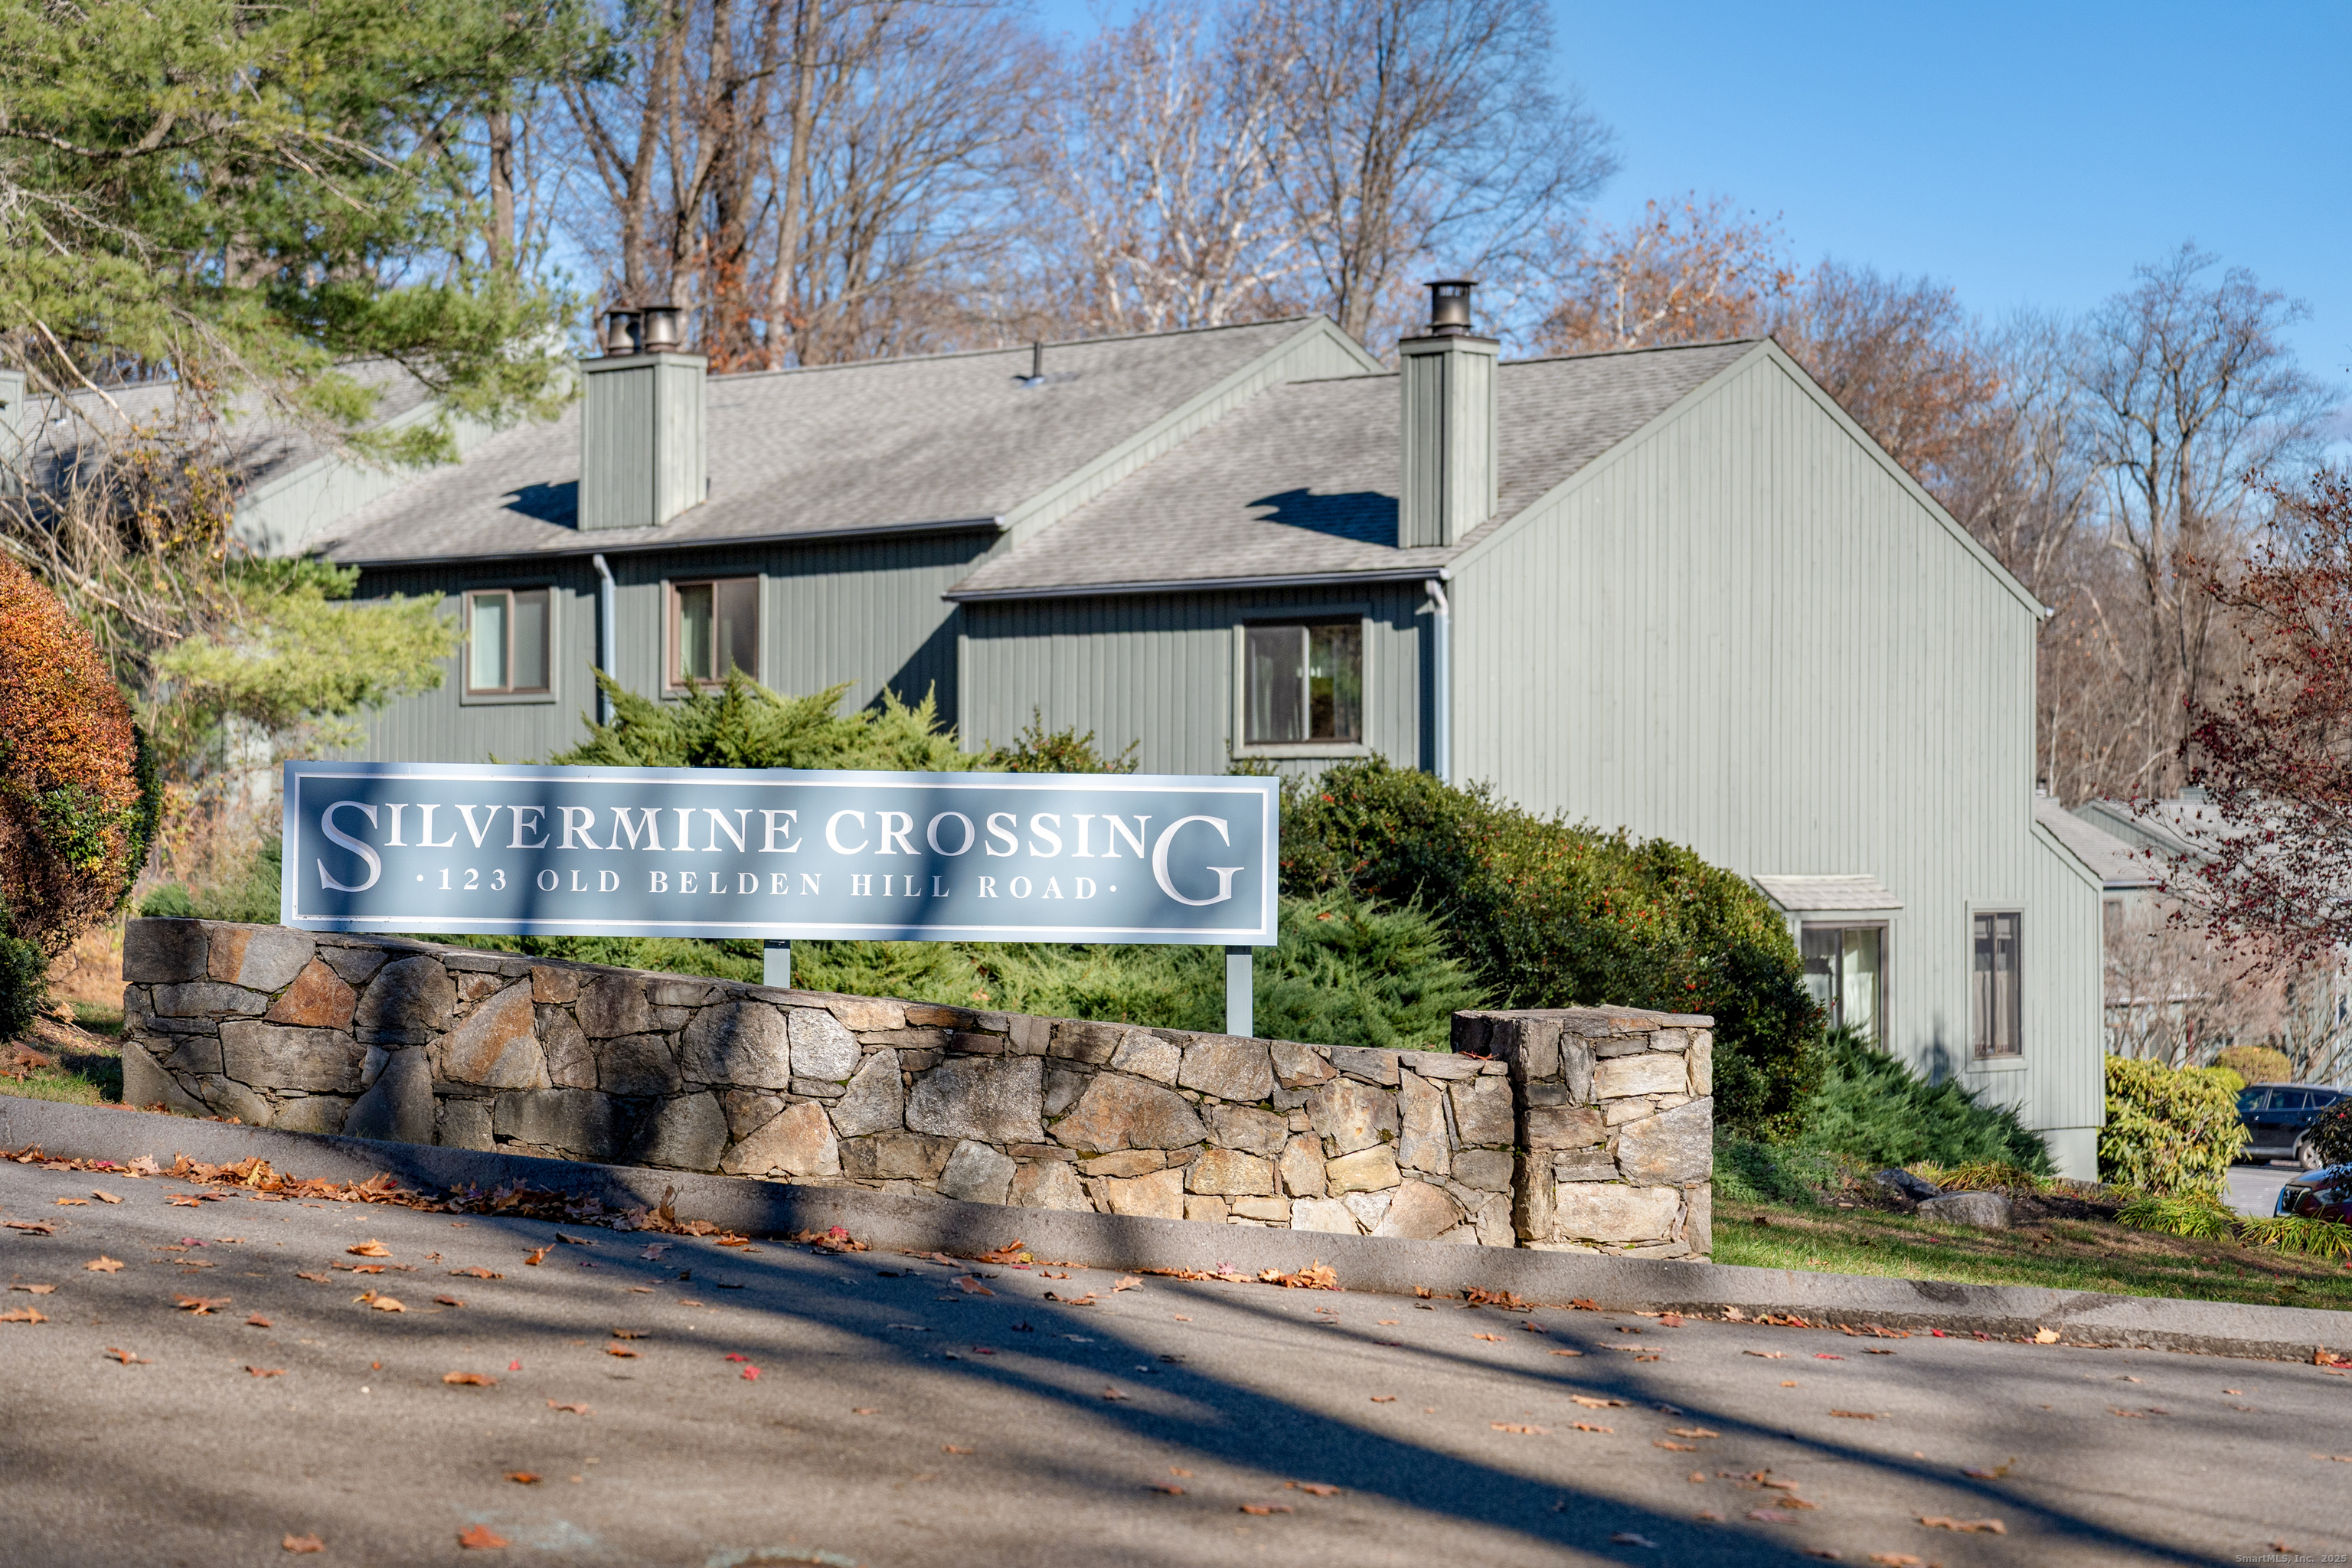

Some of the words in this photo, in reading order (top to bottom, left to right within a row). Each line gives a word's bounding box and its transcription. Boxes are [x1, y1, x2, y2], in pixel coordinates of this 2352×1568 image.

[317, 800, 802, 893] SILVERMINE
[825, 809, 1245, 906] CROSSING
[536, 869, 621, 893] OLD
[648, 871, 822, 896] BELDEN
[850, 874, 950, 897] HILL
